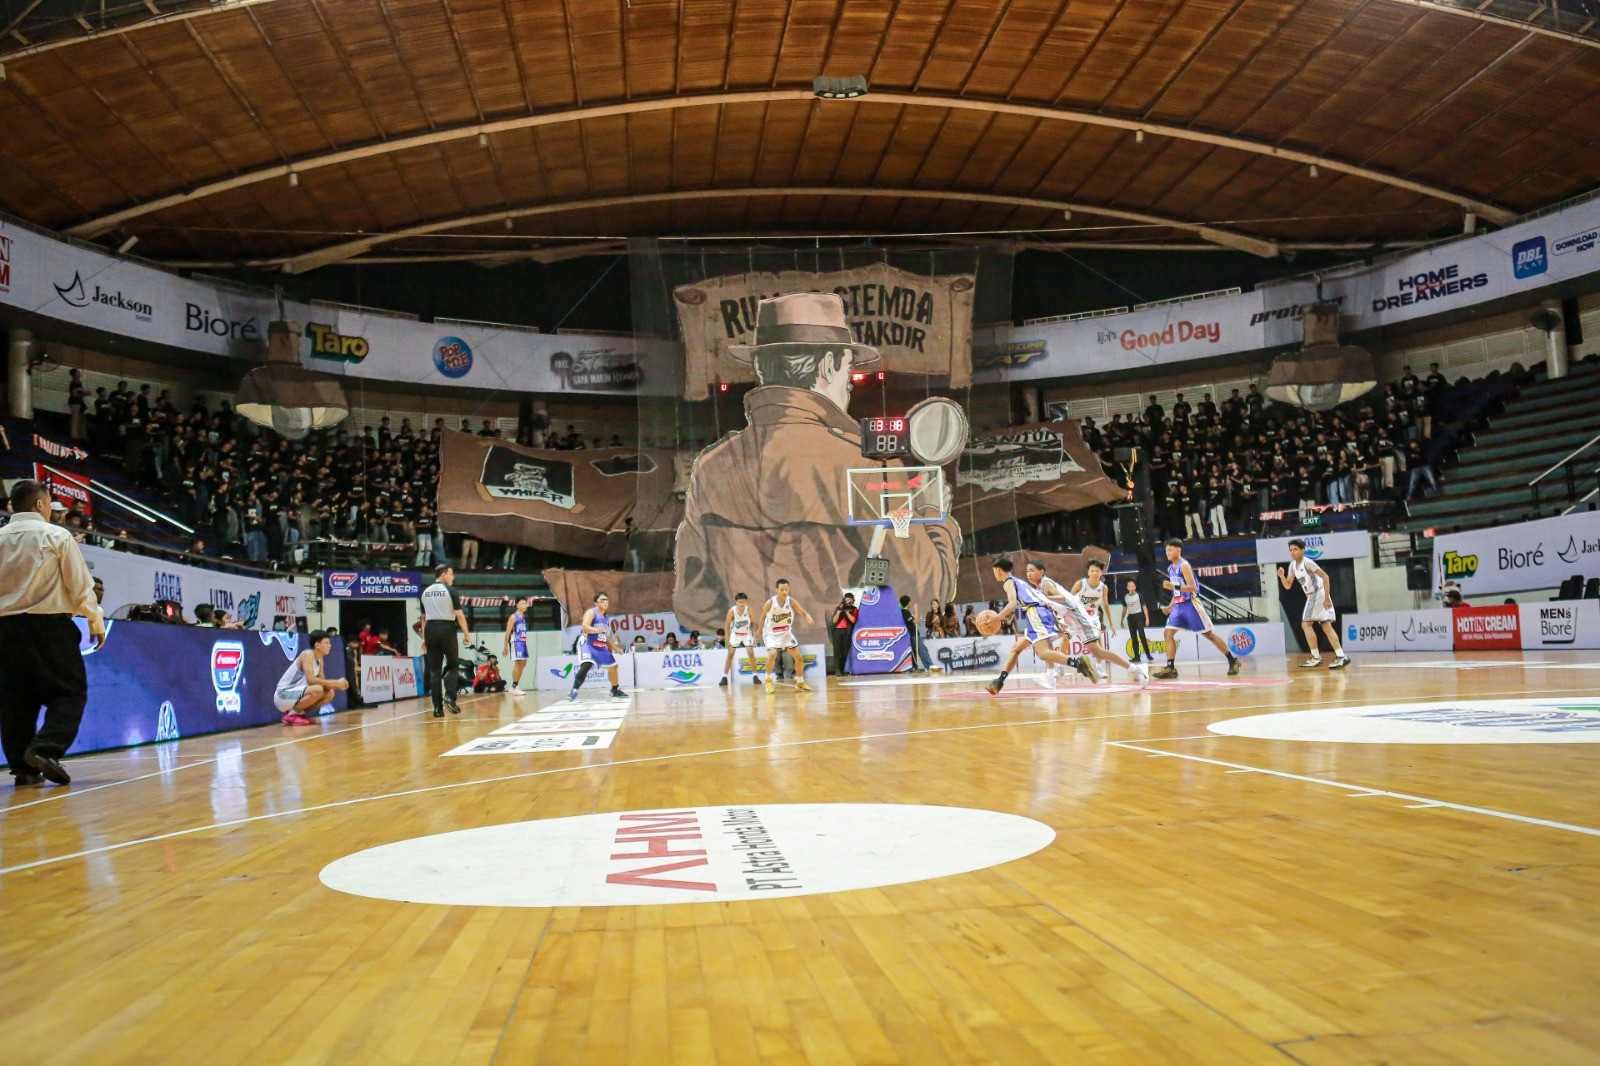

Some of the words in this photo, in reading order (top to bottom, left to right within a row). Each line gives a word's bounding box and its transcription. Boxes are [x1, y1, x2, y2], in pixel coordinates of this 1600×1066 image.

[1556, 232, 1598, 251] DOWNLOAD
[1577, 242, 1594, 253] NOW
[1517, 247, 1543, 265] DBL
[1517, 259, 1542, 271] PLAY
[1399, 264, 1459, 291] HOME
[92, 286, 152, 315] Jackson
[1373, 273, 1489, 313] DREAMERS
[185, 303, 257, 341] Bioré
[307, 322, 369, 358] Taro
[1121, 329, 1174, 351] Good
[1178, 320, 1220, 343] Day
[439, 344, 460, 360] POP
[445, 352, 469, 370] MIE
[573, 375, 589, 385] GAYA
[1303, 517, 1319, 525] EXIT
[1304, 536, 1324, 549] QUA
[1444, 550, 1478, 574] Taro
[1498, 542, 1544, 570] Bioré
[153, 571, 183, 602] AQUA
[360, 576, 391, 585] HOME
[360, 585, 418, 594] DREAMERS
[209, 588, 235, 610] ULTRA
[424, 590, 446, 598] REFEREE
[633, 614, 665, 635] Day
[1418, 621, 1448, 634] Jackson
[1457, 616, 1475, 632] HOT
[1484, 614, 1517, 632] CREAM
[1541, 620, 1572, 636] Bioré
[1231, 631, 1246, 643] POP
[1360, 624, 1389, 641] gopay
[1236, 637, 1253, 651] MIE
[662, 654, 704, 669] AQUA
[366, 665, 390, 681] AHM
[721, 808, 758, 826] Motor
[723, 825, 777, 850] Honda
[605, 810, 718, 892] AHM
[742, 850, 794, 874] Astra
[746, 877, 803, 891] PT
